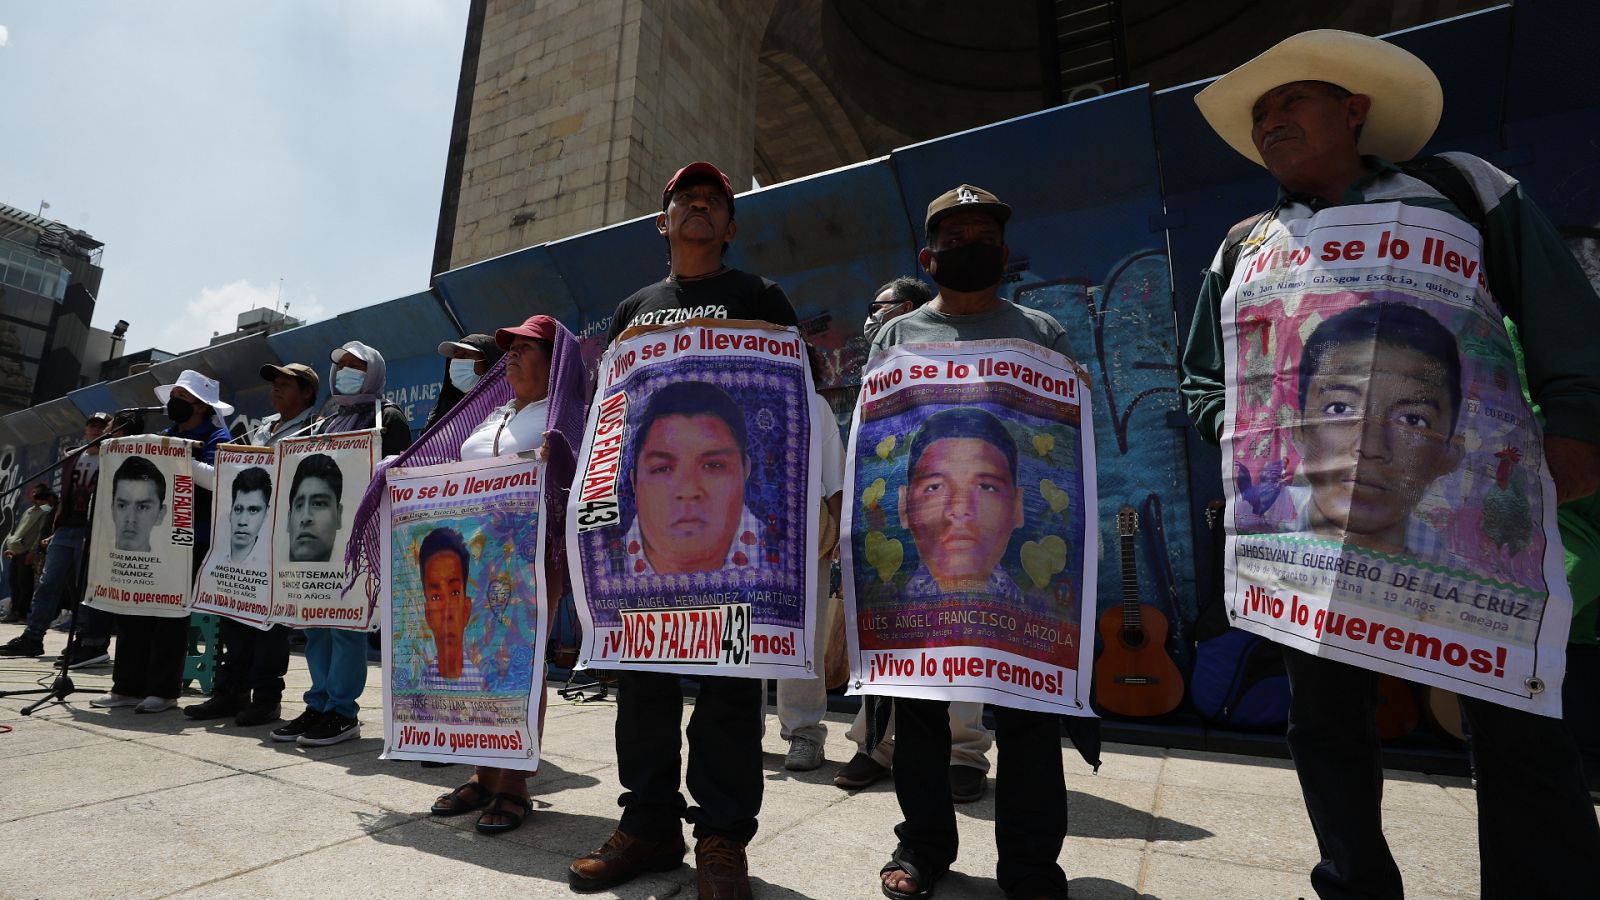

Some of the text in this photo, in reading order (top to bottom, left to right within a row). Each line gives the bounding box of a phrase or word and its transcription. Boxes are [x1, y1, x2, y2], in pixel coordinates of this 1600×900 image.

[957, 187, 980, 204] LA
[1244, 246, 1311, 283] ¡Vivo
[1320, 241, 1365, 262] se
[1377, 231, 1410, 261] lo
[1242, 289, 1255, 298] Yo,
[1313, 275, 1362, 285] Glasgow
[1366, 273, 1418, 288] Escocia,
[1425, 280, 1459, 299] quiero
[608, 328, 801, 387] ¡Vivo se lo llevaron!
[862, 358, 1075, 403] ¡Vivo se lo llevaron!
[135, 442, 143, 455] lo
[219, 451, 242, 466] ¡Vivo
[242, 454, 254, 465] se
[255, 453, 264, 465] lo
[303, 443, 315, 453] se
[315, 441, 325, 452] lo
[326, 438, 369, 451] llevaron!
[578, 393, 626, 532] NOS FALTAN 43!
[417, 485, 439, 500] se
[442, 480, 459, 498] lo
[462, 466, 538, 495] llevaron!
[170, 474, 194, 547] NOS FALTAN 43!
[124, 554, 162, 564] MANUEL
[121, 590, 131, 602] lo
[133, 591, 183, 606] queremos!
[216, 580, 257, 592] VILLEGAS
[301, 581, 343, 590] GARCÍA
[303, 592, 331, 600] AÑOS
[1302, 552, 1381, 582] GUERRERO
[1392, 573, 1420, 592] DE
[1433, 583, 1460, 603] LA
[1473, 593, 1529, 620] CRUZ
[198, 592, 213, 604] ¡Con
[213, 594, 229, 607] VIDA
[229, 597, 236, 609] lo
[302, 606, 364, 621] queremos!
[594, 596, 631, 609] MIGUEL
[637, 593, 669, 608] ÁNGEL
[676, 591, 740, 608] HERNÁNDEZ
[1312, 575, 1318, 586] y
[1384, 591, 1399, 602] 19
[1404, 597, 1436, 613] Años
[1459, 611, 1510, 633] Omeapa
[621, 604, 752, 665] NOS FALTAN 43!
[895, 612, 932, 629] ÁNGEL
[938, 610, 1016, 631] FRANCISCO
[1024, 622, 1073, 648] ARZOLA
[1243, 585, 1507, 678] ¡Vivo lo queremos!
[870, 652, 1063, 696] ¡Vivo lo queremos!
[398, 725, 523, 753] ¡Vivo lo queremos!
